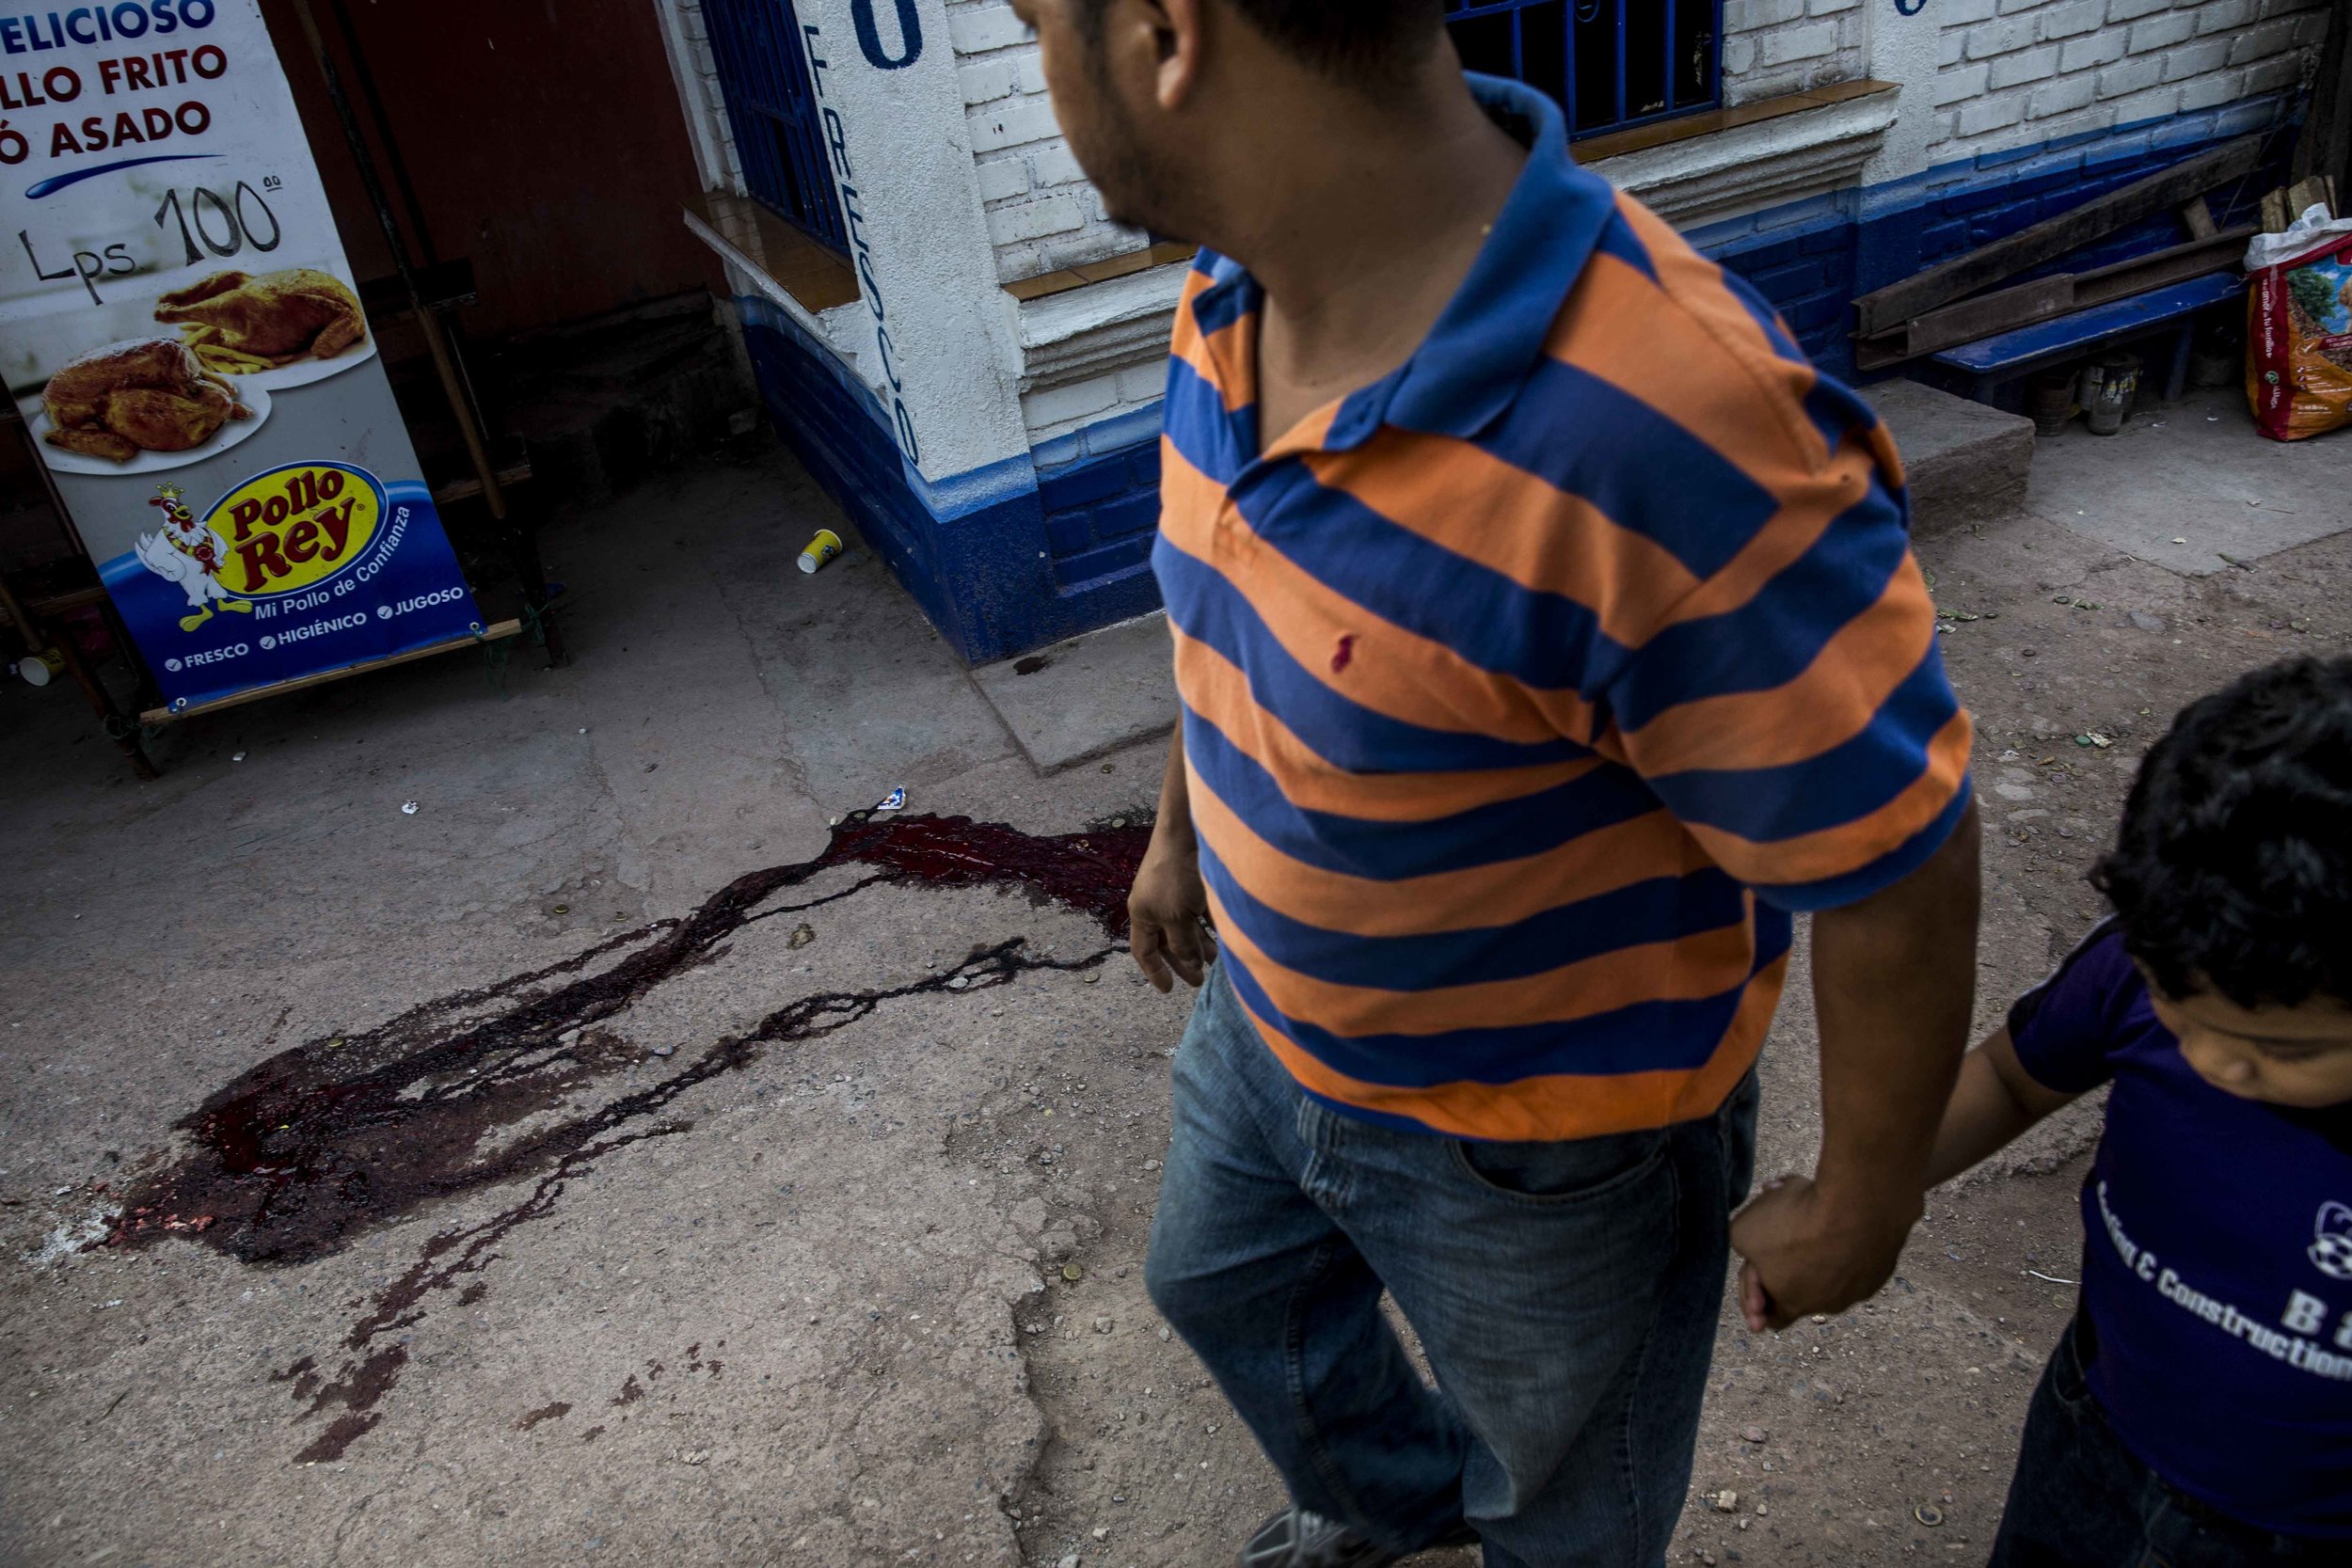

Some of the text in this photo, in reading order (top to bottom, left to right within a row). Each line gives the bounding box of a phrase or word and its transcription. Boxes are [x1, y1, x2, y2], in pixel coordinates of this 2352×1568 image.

[98, 44, 228, 95] FRITO
[50, 101, 211, 158] ASADO
[803, 24, 920, 467] FRESCO
[229, 470, 344, 541] Pollo
[235, 496, 356, 593] Rey
[254, 506, 410, 621] Mi Pollo de Confianza
[183, 586, 465, 669] FRESCO HIGIÉNICO JUGOSO
[2280, 1287, 2329, 1337] B
